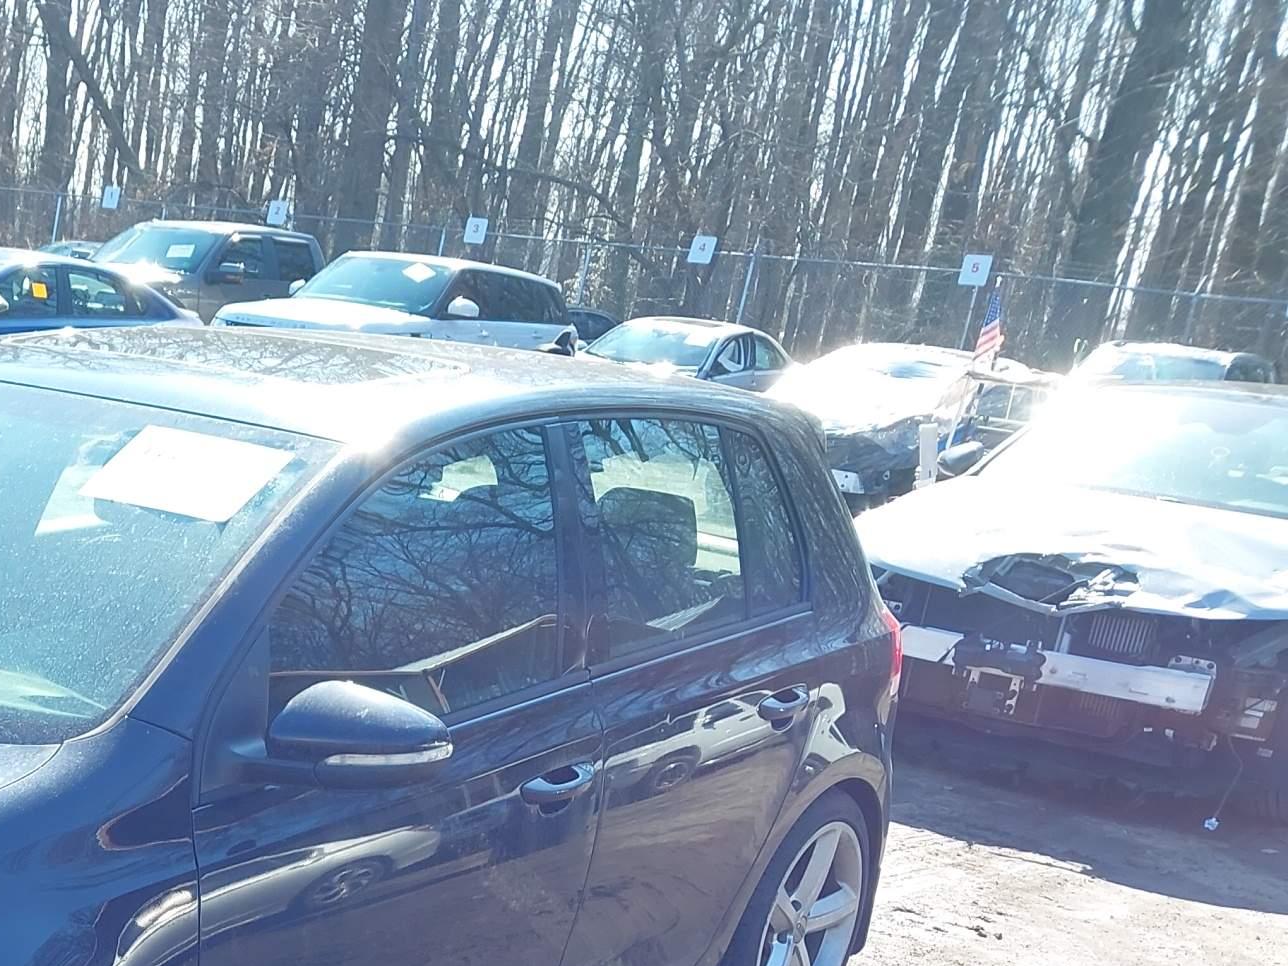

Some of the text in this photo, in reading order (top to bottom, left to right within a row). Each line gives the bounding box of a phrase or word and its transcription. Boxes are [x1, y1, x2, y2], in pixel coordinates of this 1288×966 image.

[274, 206, 281, 215] 2
[472, 223, 480, 233] 3
[698, 242, 707, 252] 4
[971, 262, 980, 273] 5
